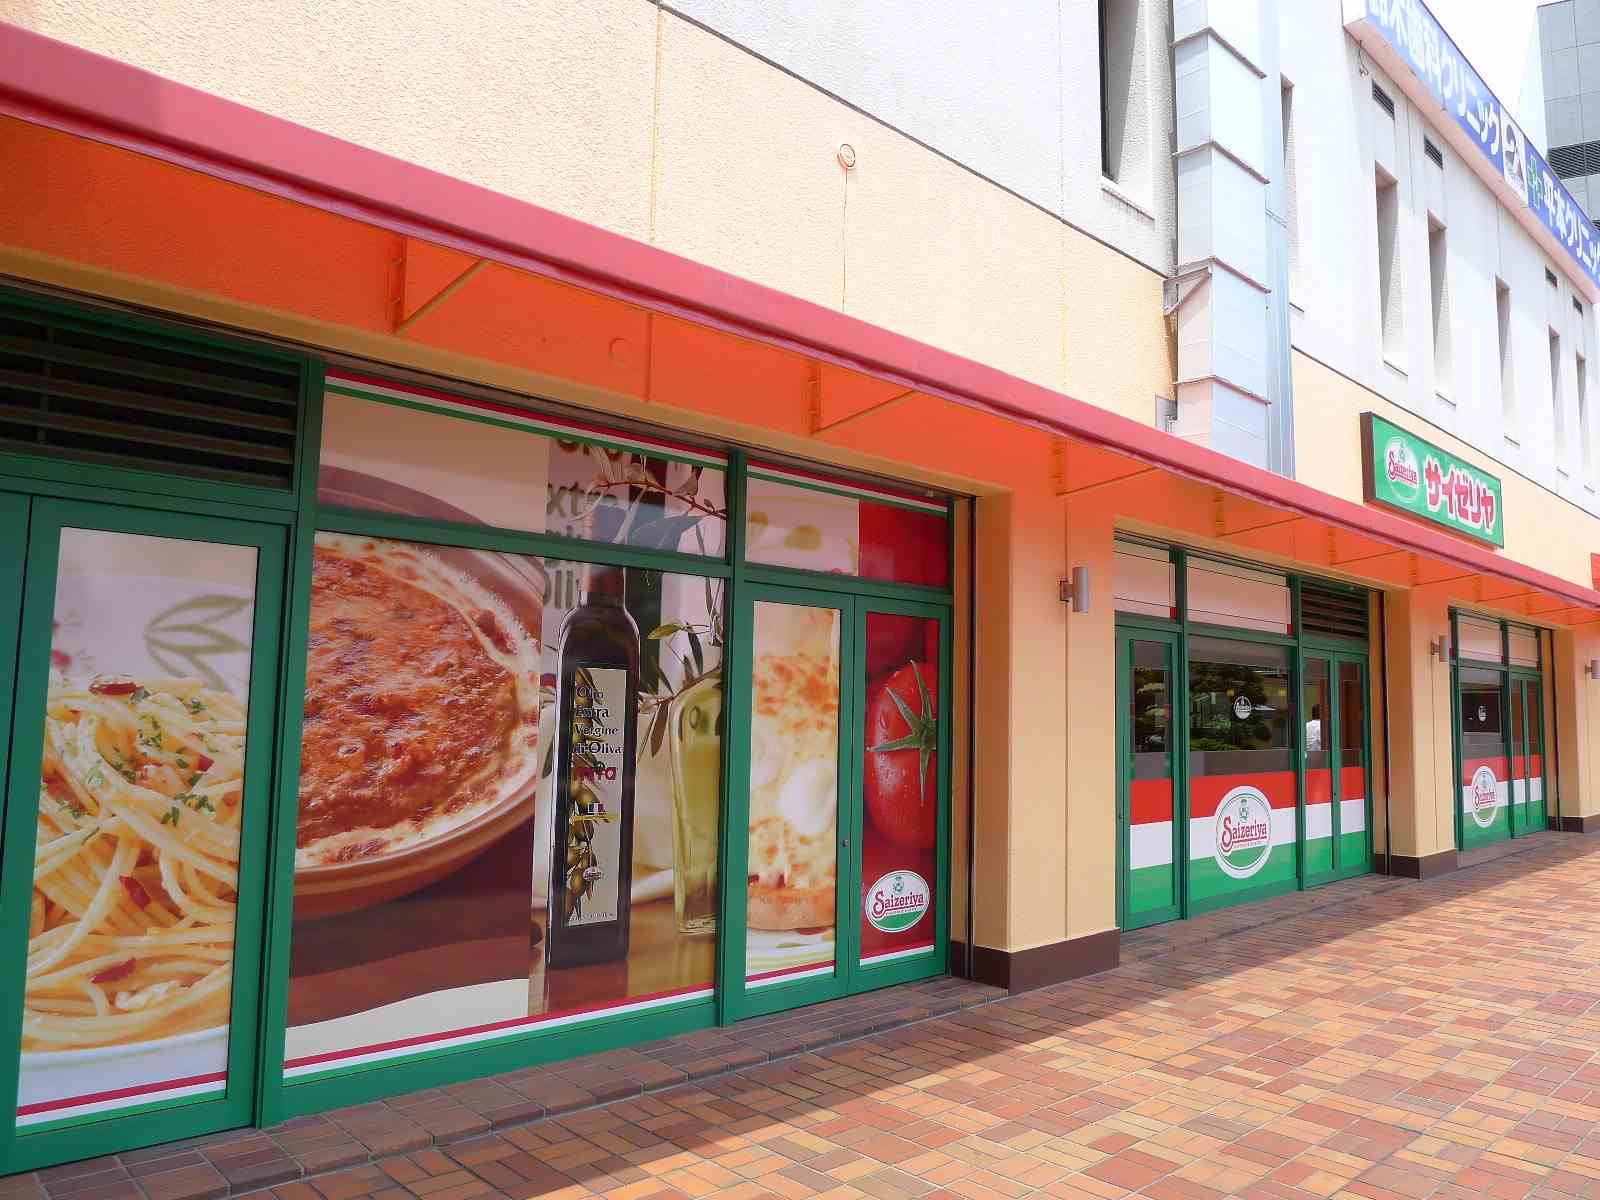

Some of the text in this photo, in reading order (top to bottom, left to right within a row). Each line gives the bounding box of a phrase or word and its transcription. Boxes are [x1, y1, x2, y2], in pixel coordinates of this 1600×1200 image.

[1424, 457, 1496, 532] サイゼリヤ
[576, 724, 618, 738] Vergine
[1221, 816, 1267, 852] Saizeriya
[873, 890, 924, 918] Saizeriya
